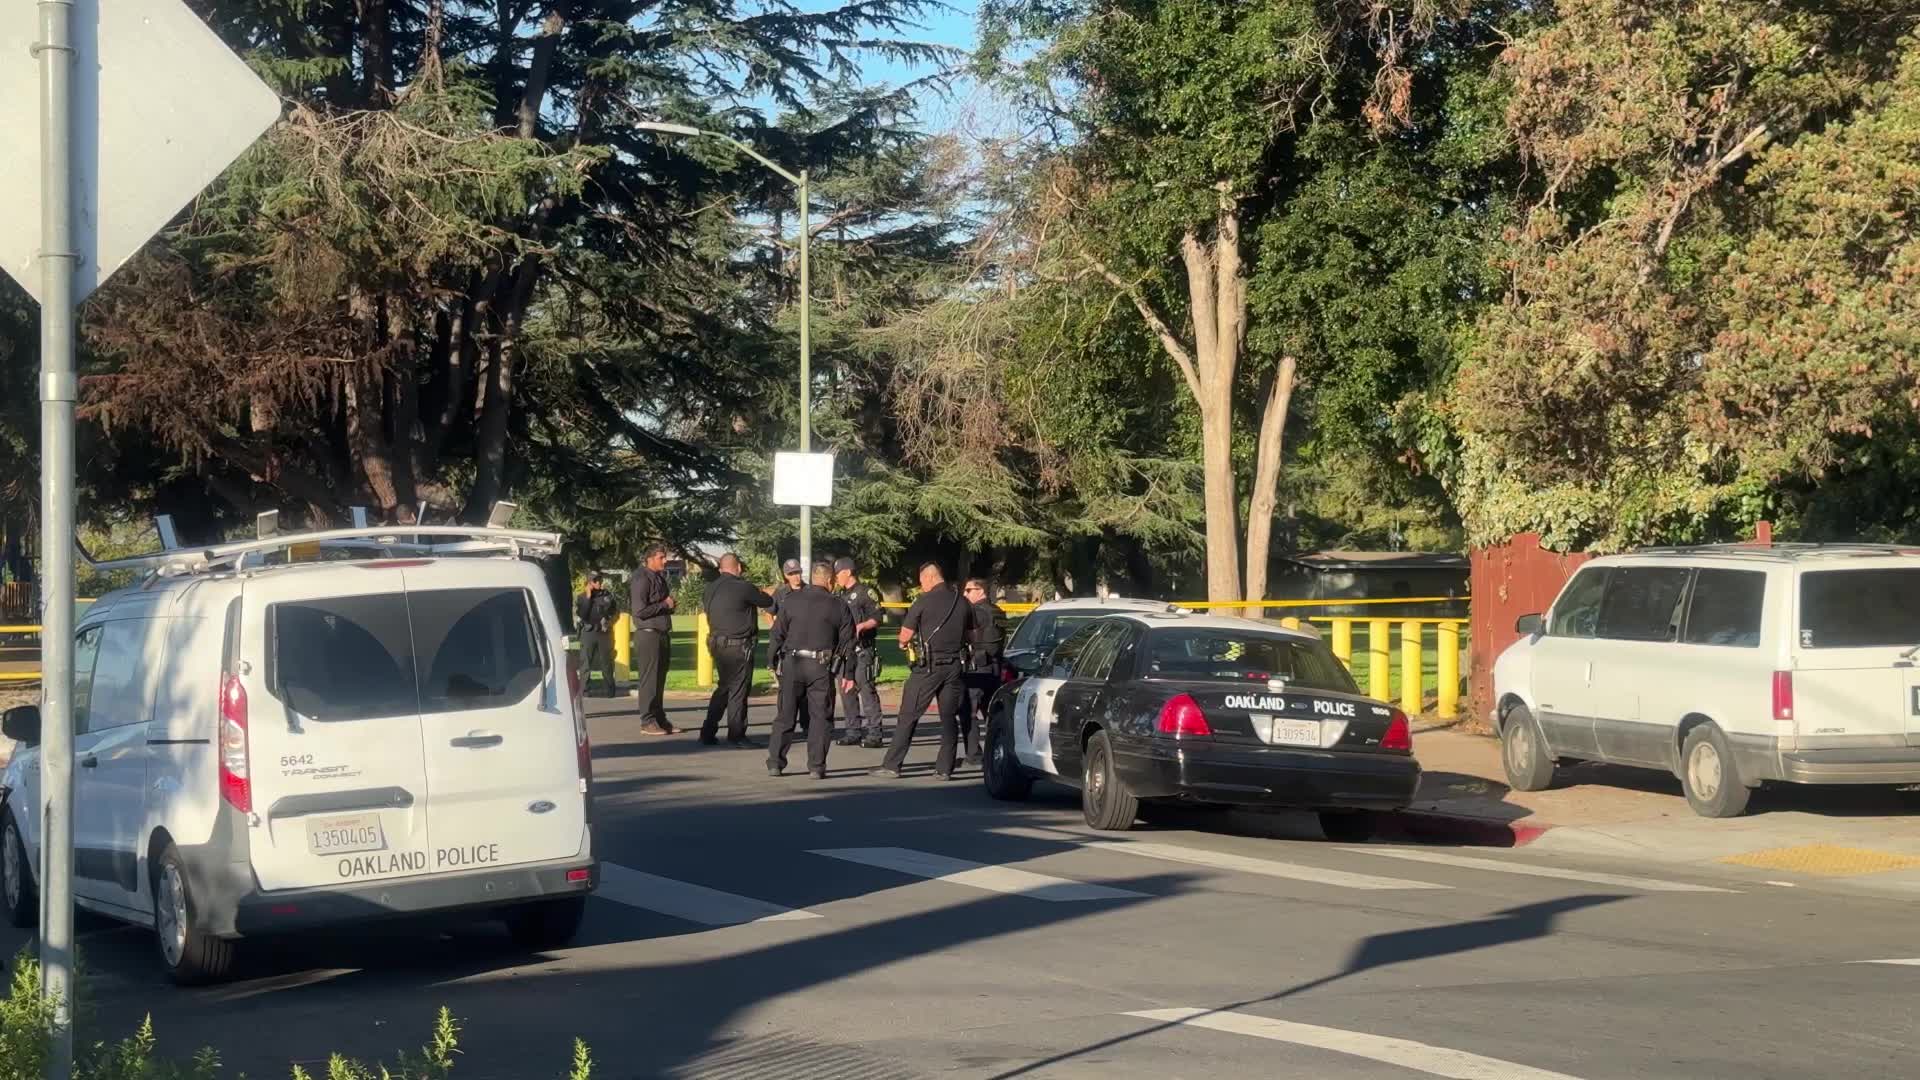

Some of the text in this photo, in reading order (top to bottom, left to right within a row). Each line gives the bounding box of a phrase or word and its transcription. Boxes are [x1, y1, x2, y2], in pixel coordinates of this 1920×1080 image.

[1225, 695, 1285, 711] OAKLAND
[1313, 700, 1356, 717] POLICE
[280, 754, 313, 767] 5642
[313, 826, 377, 849] 1350405
[338, 843, 498, 878] OAKLAND POLICE
